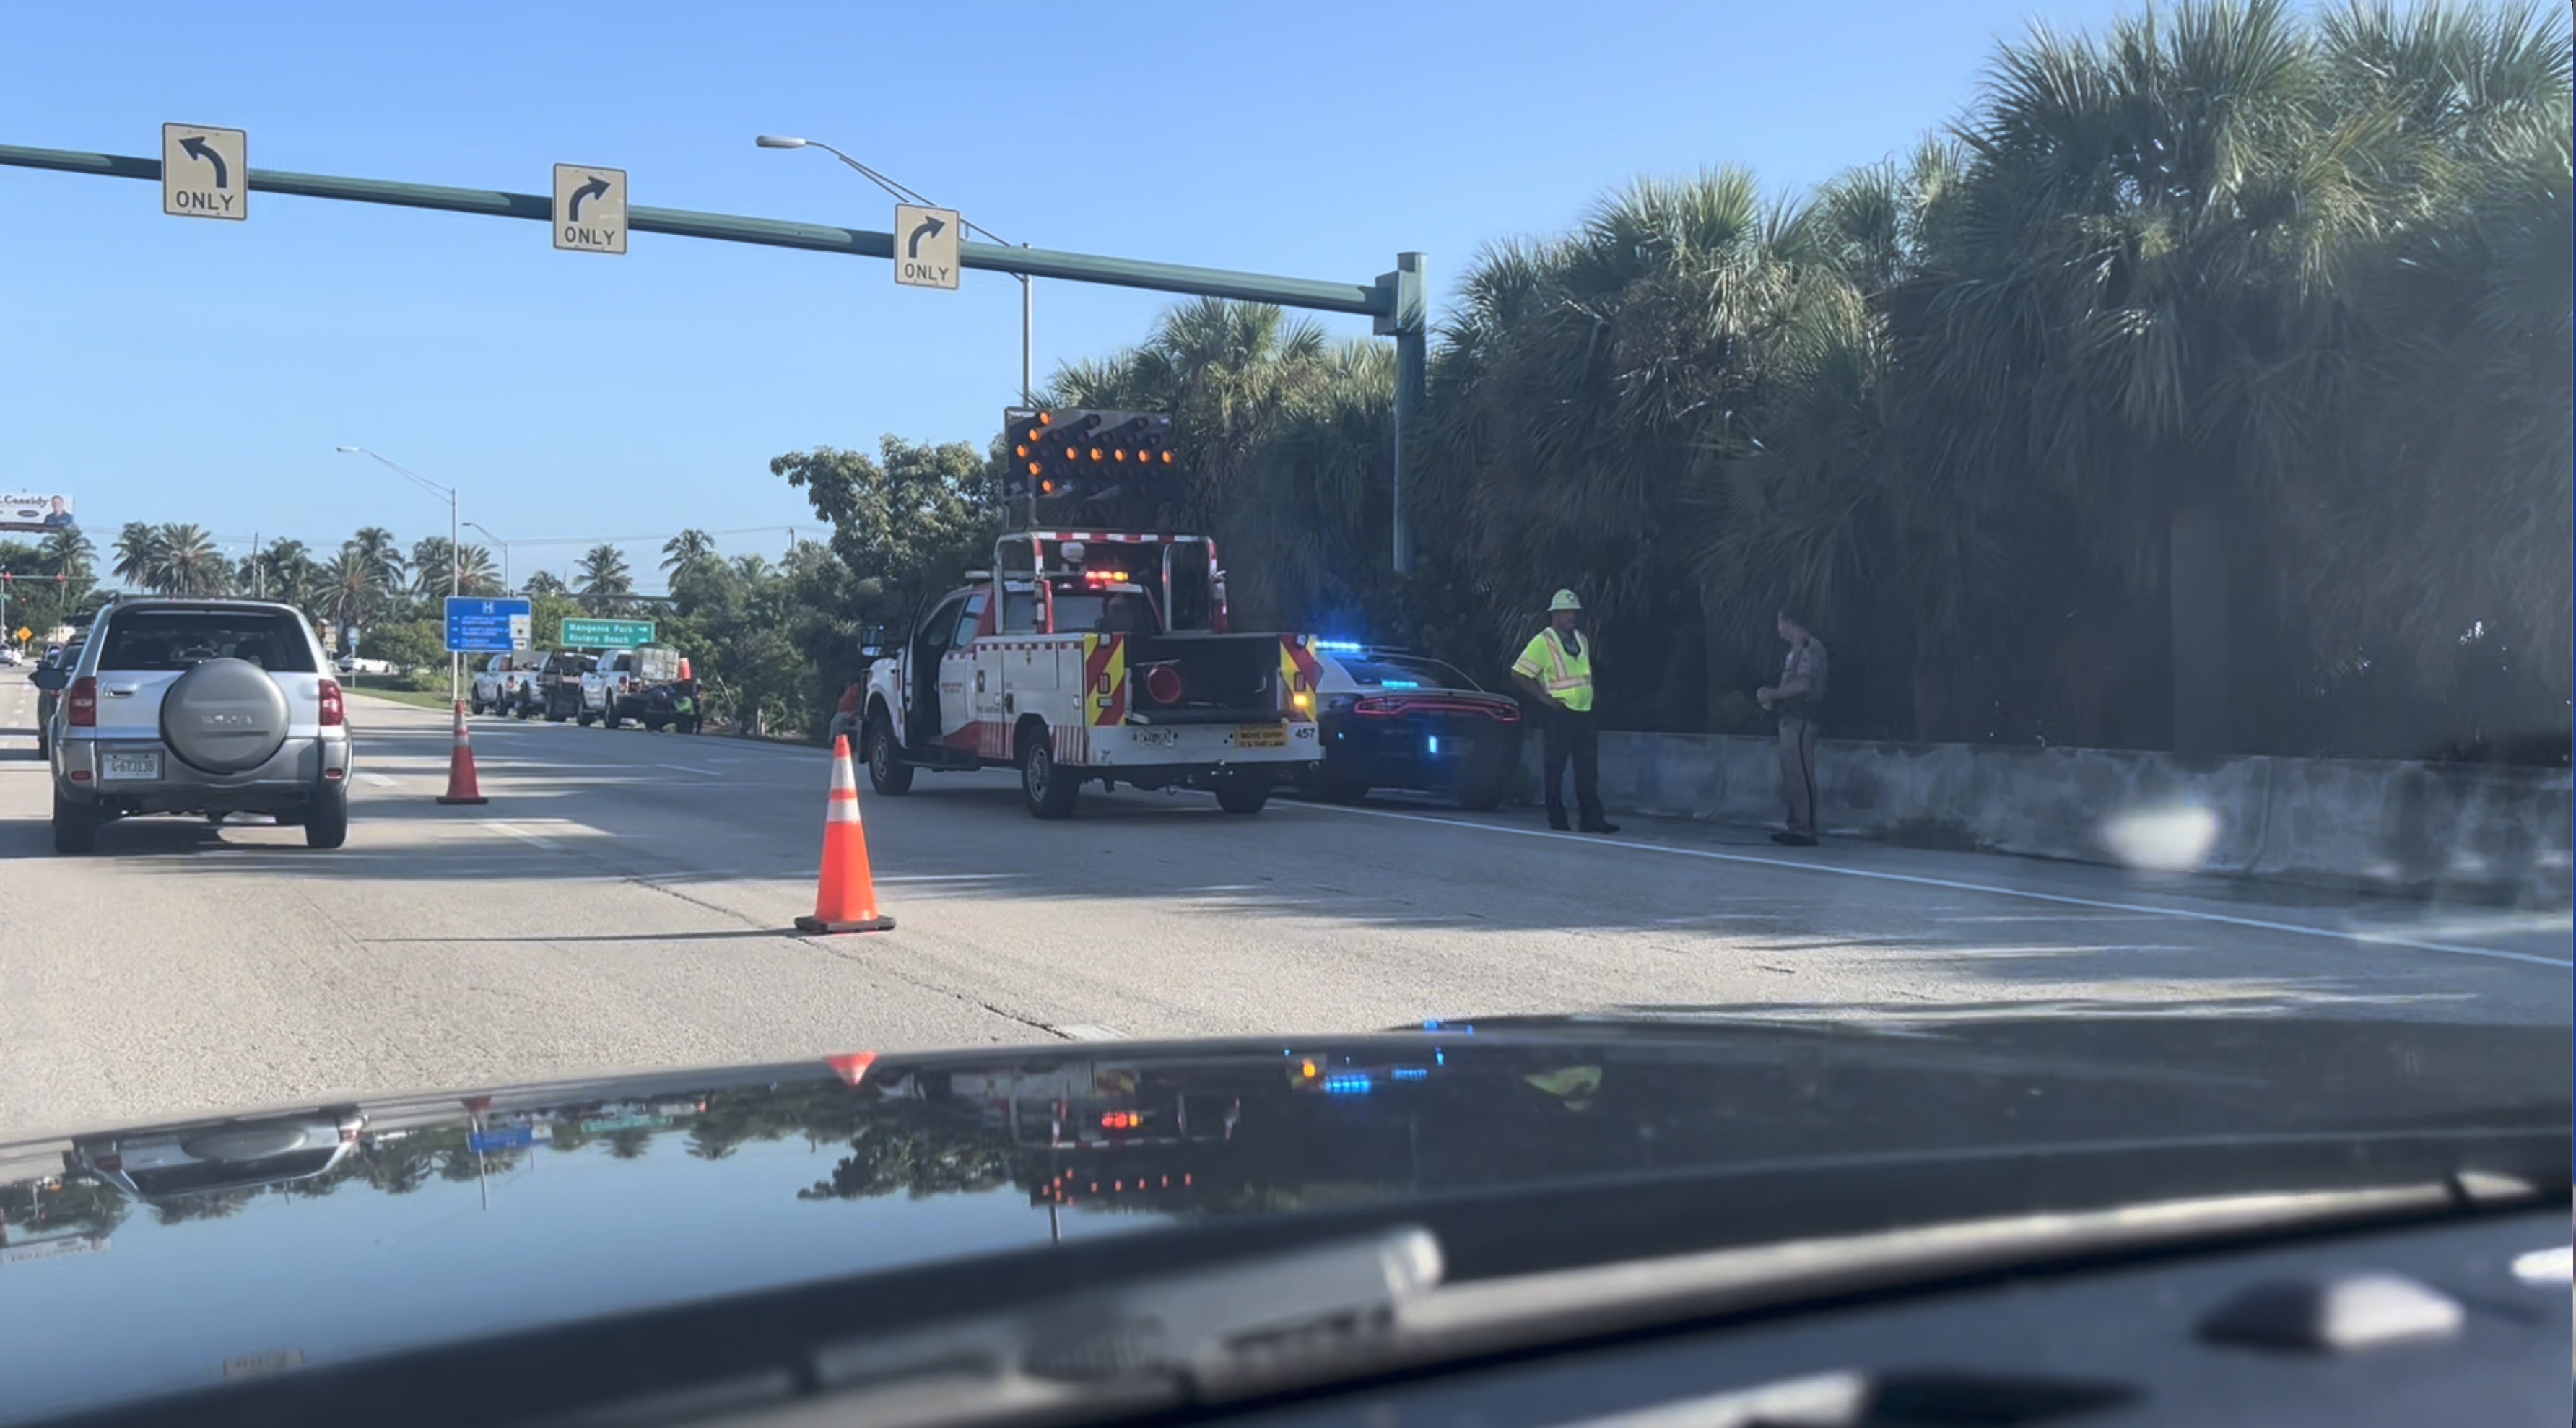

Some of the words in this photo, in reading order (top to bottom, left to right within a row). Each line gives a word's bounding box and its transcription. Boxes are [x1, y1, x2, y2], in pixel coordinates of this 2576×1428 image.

[176, 190, 234, 211] ONLY
[565, 226, 615, 245] ONLY
[905, 263, 949, 281] ONLY
[482, 601, 495, 614] H
[614, 624, 633, 633] Park
[569, 633, 599, 643] Riviera
[604, 635, 629, 643] Beach
[1295, 728, 1315, 739] 457
